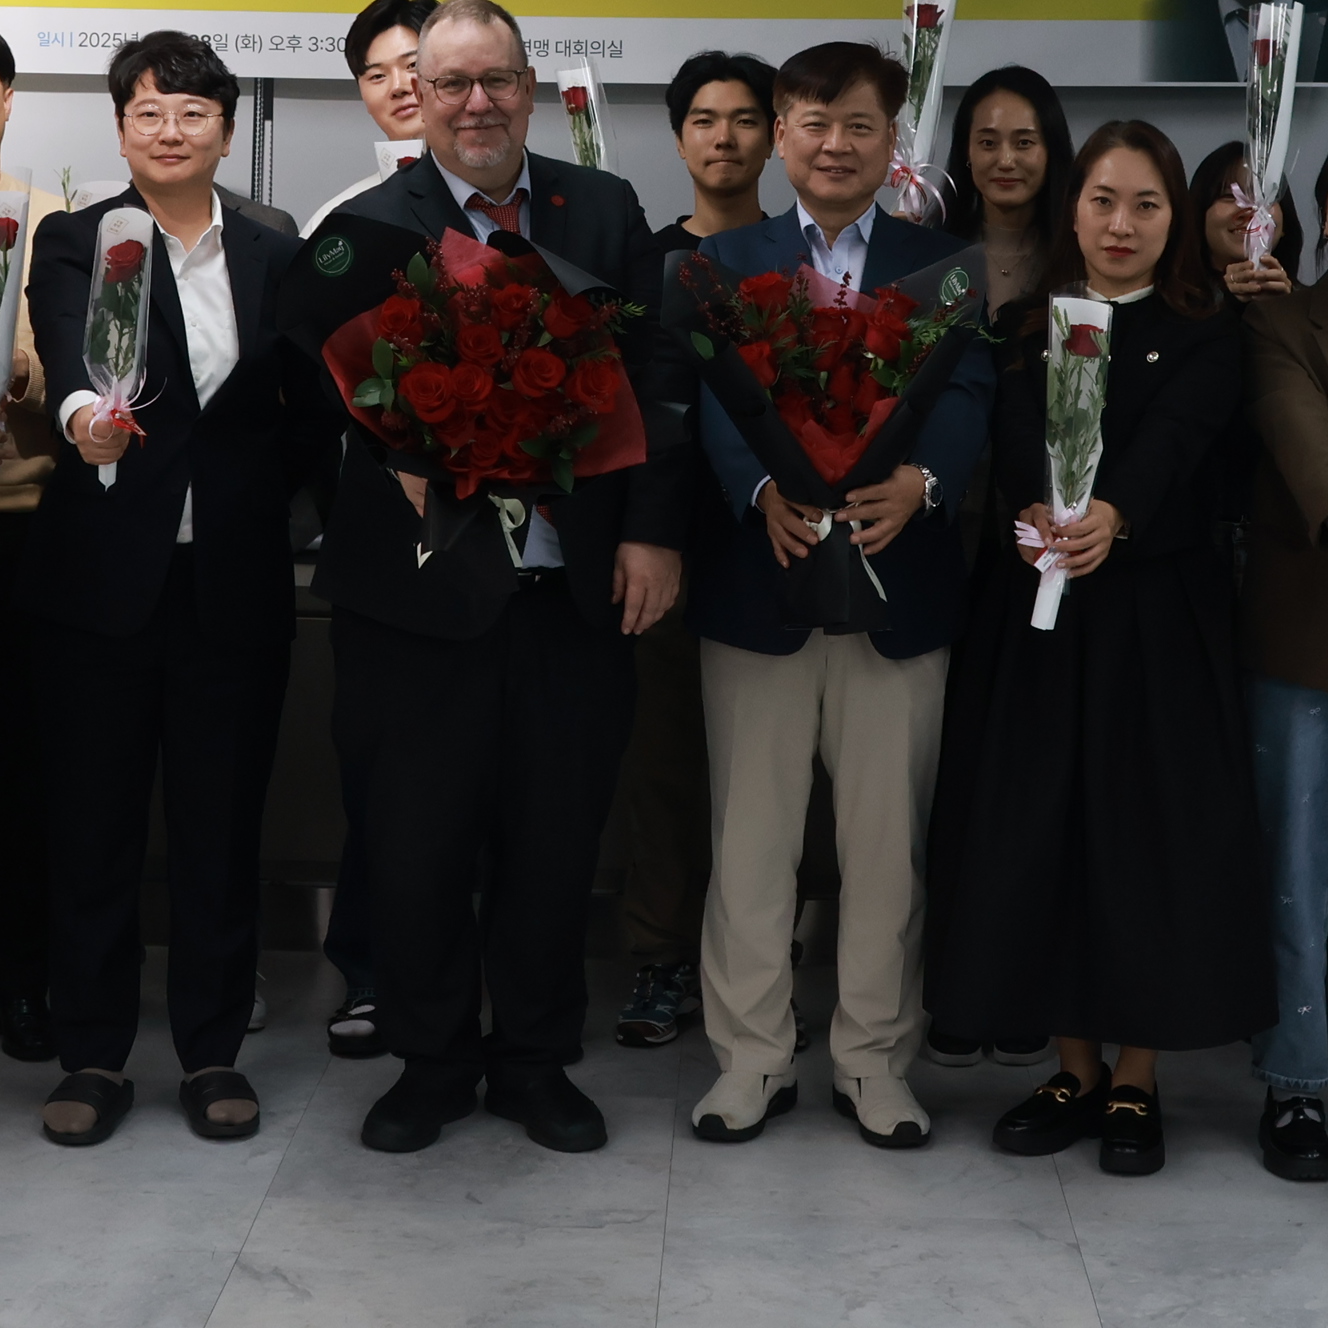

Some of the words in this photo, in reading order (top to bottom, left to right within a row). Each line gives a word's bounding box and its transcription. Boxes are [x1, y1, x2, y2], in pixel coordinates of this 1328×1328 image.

[36, 31, 65, 48] 일시
[234, 33, 263, 54] (화)
[267, 34, 303, 54] 오후
[307, 36, 347, 53] 3:30
[555, 39, 624, 59] 대회의실
